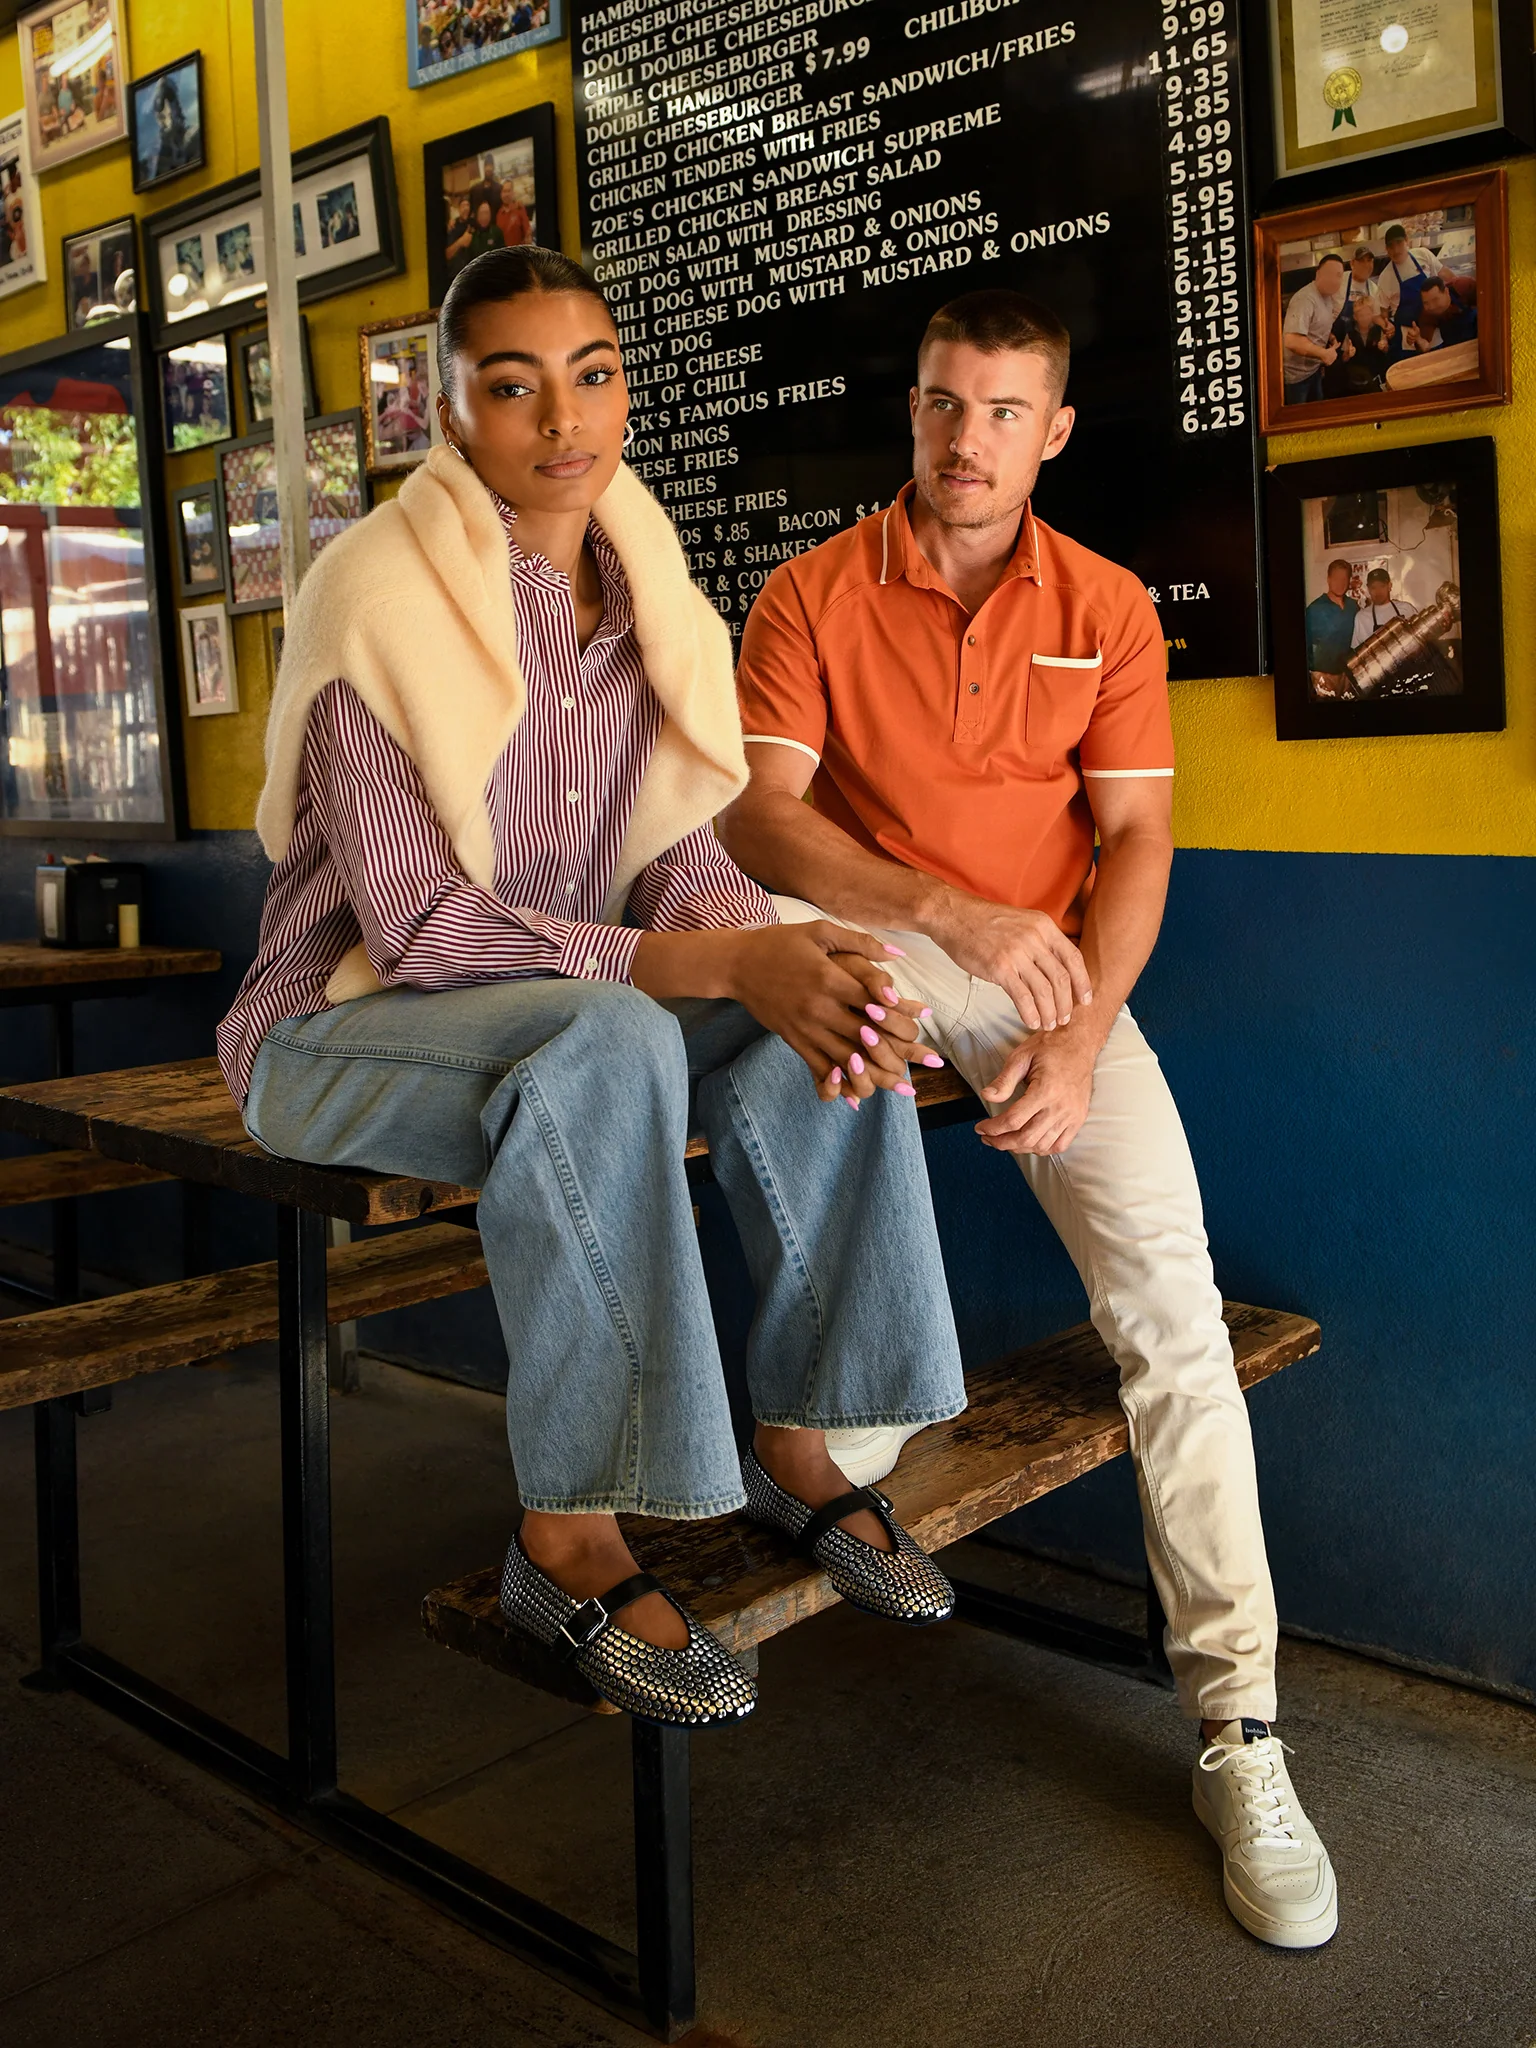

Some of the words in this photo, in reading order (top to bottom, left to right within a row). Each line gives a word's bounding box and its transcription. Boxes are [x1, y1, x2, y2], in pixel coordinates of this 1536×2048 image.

[582, 0, 669, 33] HAMBU
[1163, 2, 1224, 40] 9.99
[583, 68, 633, 100] CHILI
[641, 38, 717, 80] DOUBLE
[584, 33, 667, 79] DOUBLE
[1149, 31, 1226, 74] 11.65
[585, 87, 644, 123] TRIPLE
[648, 29, 818, 101] CHEESEBURGER
[1166, 62, 1228, 99] 9.35
[587, 105, 660, 144] DOUBLE
[667, 61, 794, 118] HAMBURGER
[589, 152, 666, 188] GRILLED
[674, 119, 764, 162] CHICKEN
[772, 91, 854, 134] BREAST
[863, 22, 1075, 105] SANDWICH/FRIES
[1168, 88, 1229, 126] 5.85
[588, 136, 636, 166] CHILI
[644, 84, 803, 148] CHEESEBURGER
[1169, 120, 1230, 154] 4.99
[590, 175, 665, 211] CHICKEN
[672, 148, 756, 187] TENDERS
[763, 131, 814, 160] WITH
[822, 110, 880, 144] FRIES
[592, 209, 644, 238] ZOE'S
[652, 179, 743, 220] CHICKEN
[753, 140, 874, 192] SANDWICH
[884, 103, 1001, 154] SUPREME
[1171, 150, 1231, 184] 5.59
[593, 226, 670, 260] GRILLED
[678, 197, 766, 236] CHICKEN
[776, 172, 858, 210] BREAST
[867, 150, 941, 185] SALAD
[1172, 180, 1233, 216] 5.95
[594, 251, 659, 282] GARDEN
[666, 236, 720, 264] SALAD
[727, 220, 773, 247] WITH
[787, 191, 881, 232] DRESSING
[1174, 206, 1234, 242] 5.15
[604, 281, 632, 301] OT
[640, 269, 680, 294] DOG
[687, 254, 738, 281] WITH
[754, 225, 854, 265] MUSTARD
[864, 218, 881, 237] &
[891, 190, 981, 229] ONIONS
[1174, 236, 1236, 270] 5.15
[611, 301, 645, 322] HILI
[653, 289, 693, 313] DOG
[701, 274, 753, 301] WITH
[769, 246, 870, 285] MUSTARD
[880, 239, 897, 258] &
[907, 213, 998, 251] ONIONS
[654, 304, 729, 336] CHEESE
[737, 292, 780, 317] DOG
[788, 276, 845, 304] WITH
[862, 247, 971, 288] MUSTARD
[982, 240, 1000, 260] &
[1011, 212, 1110, 252] ONIONS
[1176, 262, 1236, 294] 6.25
[1177, 290, 1238, 323] 3.25
[671, 332, 712, 355] DOG
[1178, 316, 1239, 348] 4.15
[686, 344, 762, 374] CHEESE
[1180, 346, 1241, 378] 5.65
[662, 384, 685, 403] OF
[694, 371, 746, 396] CHILI
[680, 392, 768, 424] FAMOUS
[778, 376, 845, 405] FRIES
[1180, 375, 1242, 406] 4.65
[1183, 403, 1244, 432] 6.25
[671, 425, 729, 450] RINGS
[684, 447, 738, 471] FRIES
[663, 476, 716, 499] FRIES
[735, 489, 787, 512] FRIES
[779, 508, 840, 532] BACON
[724, 550, 736, 566] &
[717, 575, 730, 591] &
[1169, 583, 1210, 601] TEA
